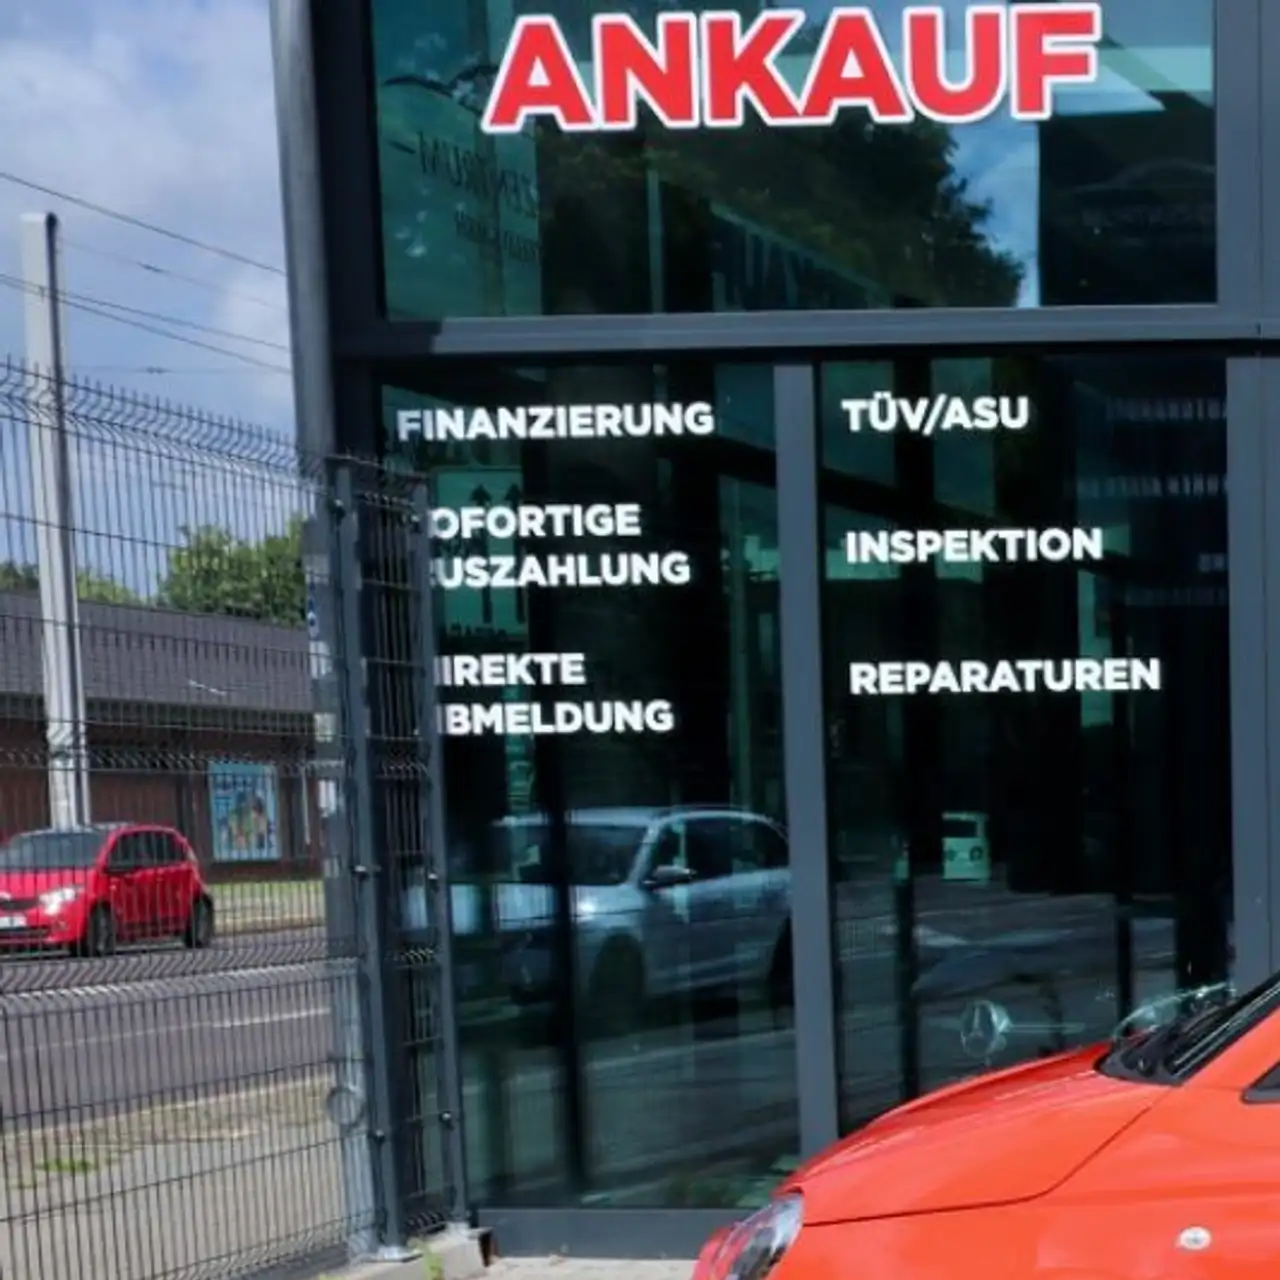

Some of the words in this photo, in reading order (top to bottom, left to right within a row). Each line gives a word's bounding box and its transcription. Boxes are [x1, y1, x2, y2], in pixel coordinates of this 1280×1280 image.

[482, 2, 1102, 133] ANKAUF
[396, 402, 715, 441] FINANZIERUNG
[841, 392, 1029, 435] TÜV/ASU
[428, 503, 642, 539] OFORTIGE
[846, 527, 1103, 563] INSPEKTION
[429, 551, 691, 588] USZAHLUNG
[433, 653, 586, 686] IREKTE
[849, 658, 1161, 695] REPARATUREN
[436, 699, 674, 735] BMELDUNG
